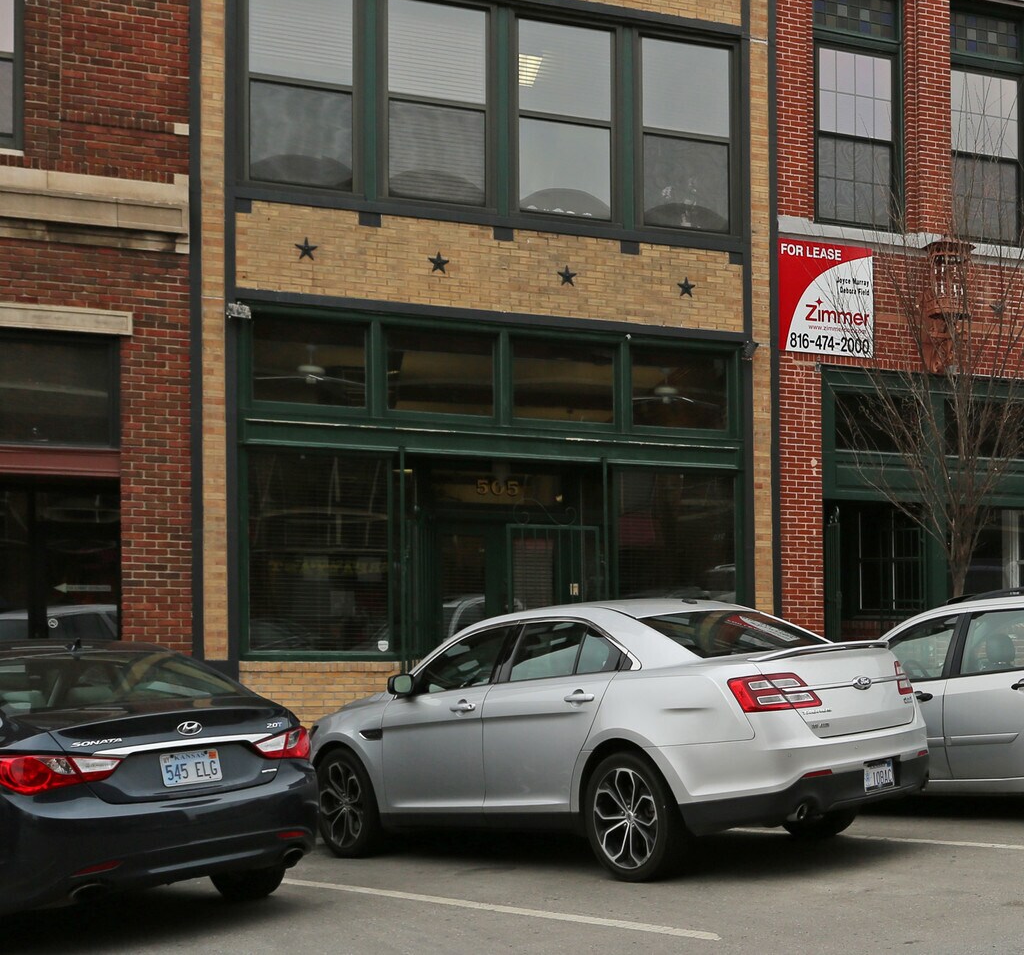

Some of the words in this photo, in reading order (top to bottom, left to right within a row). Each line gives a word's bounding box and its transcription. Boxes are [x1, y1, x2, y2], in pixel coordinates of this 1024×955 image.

[780, 243, 804, 257] FOR
[806, 246, 842, 261] LEASE
[836, 277, 851, 286] Joyce
[852, 278, 870, 288] Murray
[858, 288, 870, 296] Field
[805, 299, 870, 326] Zimmer
[789, 332, 870, 354] 816-474-2000
[476, 479, 520, 498] 505
[70, 737, 123, 748] SONATA
[174, 752, 206, 761] KANSAS
[165, 762, 189, 781] 545
[194, 760, 218, 778] ELG
